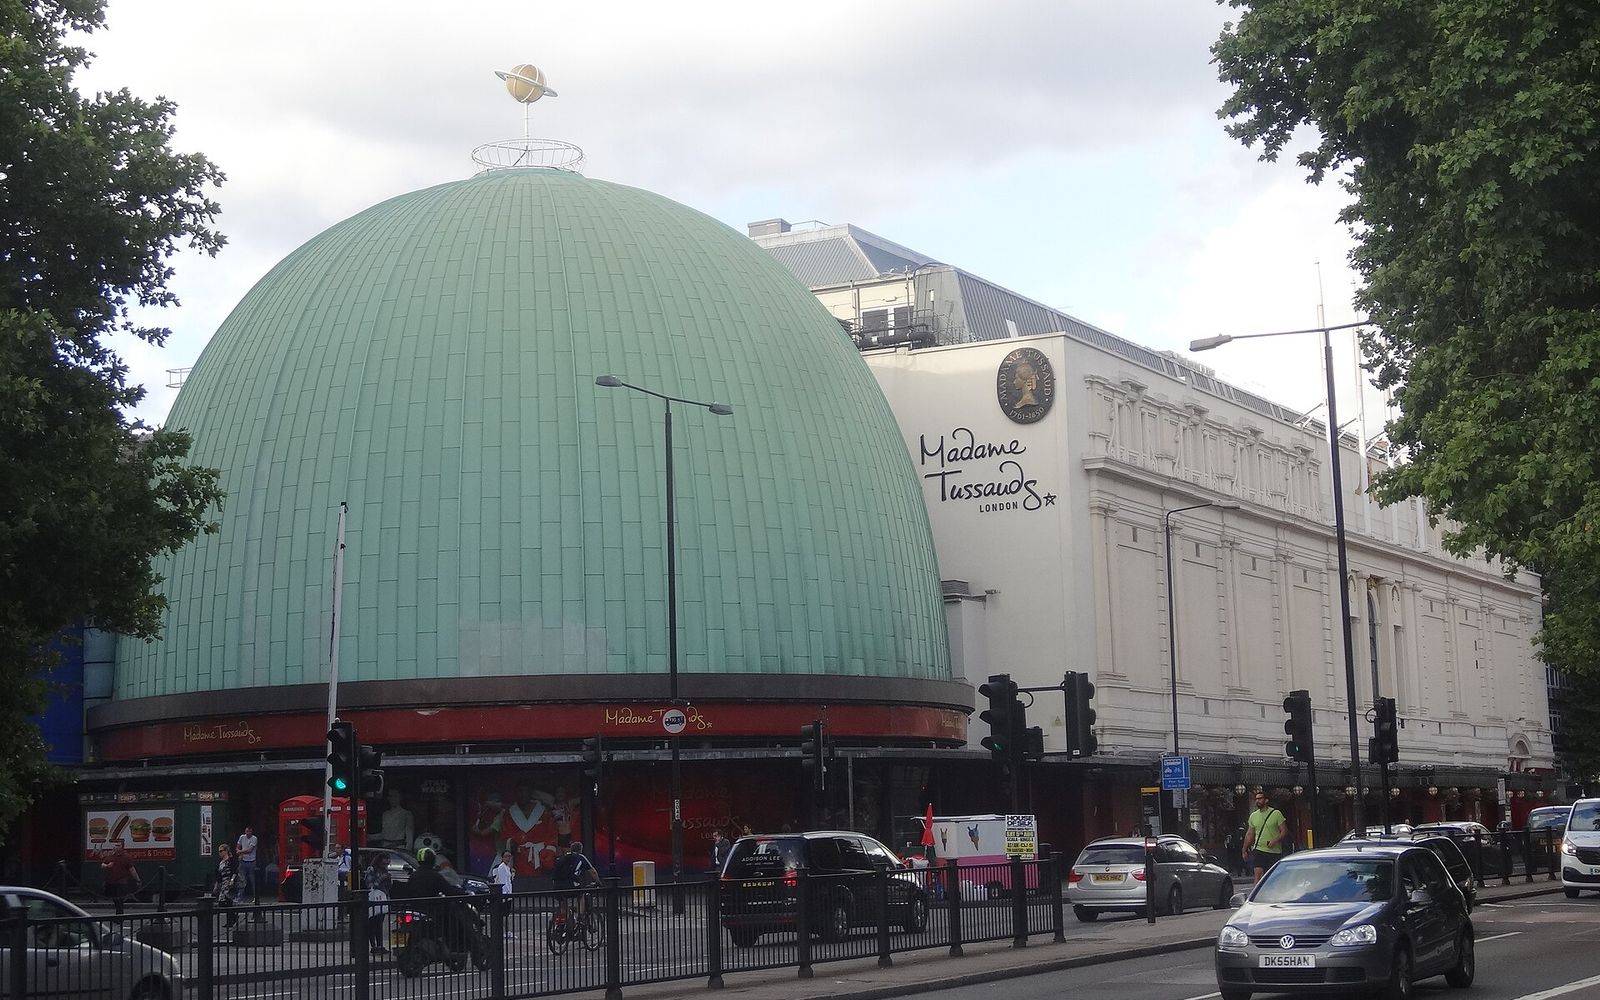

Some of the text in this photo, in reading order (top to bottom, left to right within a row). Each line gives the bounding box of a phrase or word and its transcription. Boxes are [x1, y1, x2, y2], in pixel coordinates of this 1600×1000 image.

[1000, 350, 1051, 400] MADAME TUSSAUD
[920, 427, 1027, 468] Madame
[924, 460, 1042, 511] Tussauds
[979, 501, 1018, 513] LONDON
[605, 707, 656, 726] Madame
[184, 721, 256, 745] Madame Tussauds
[1264, 956, 1310, 966] DK55HAN
